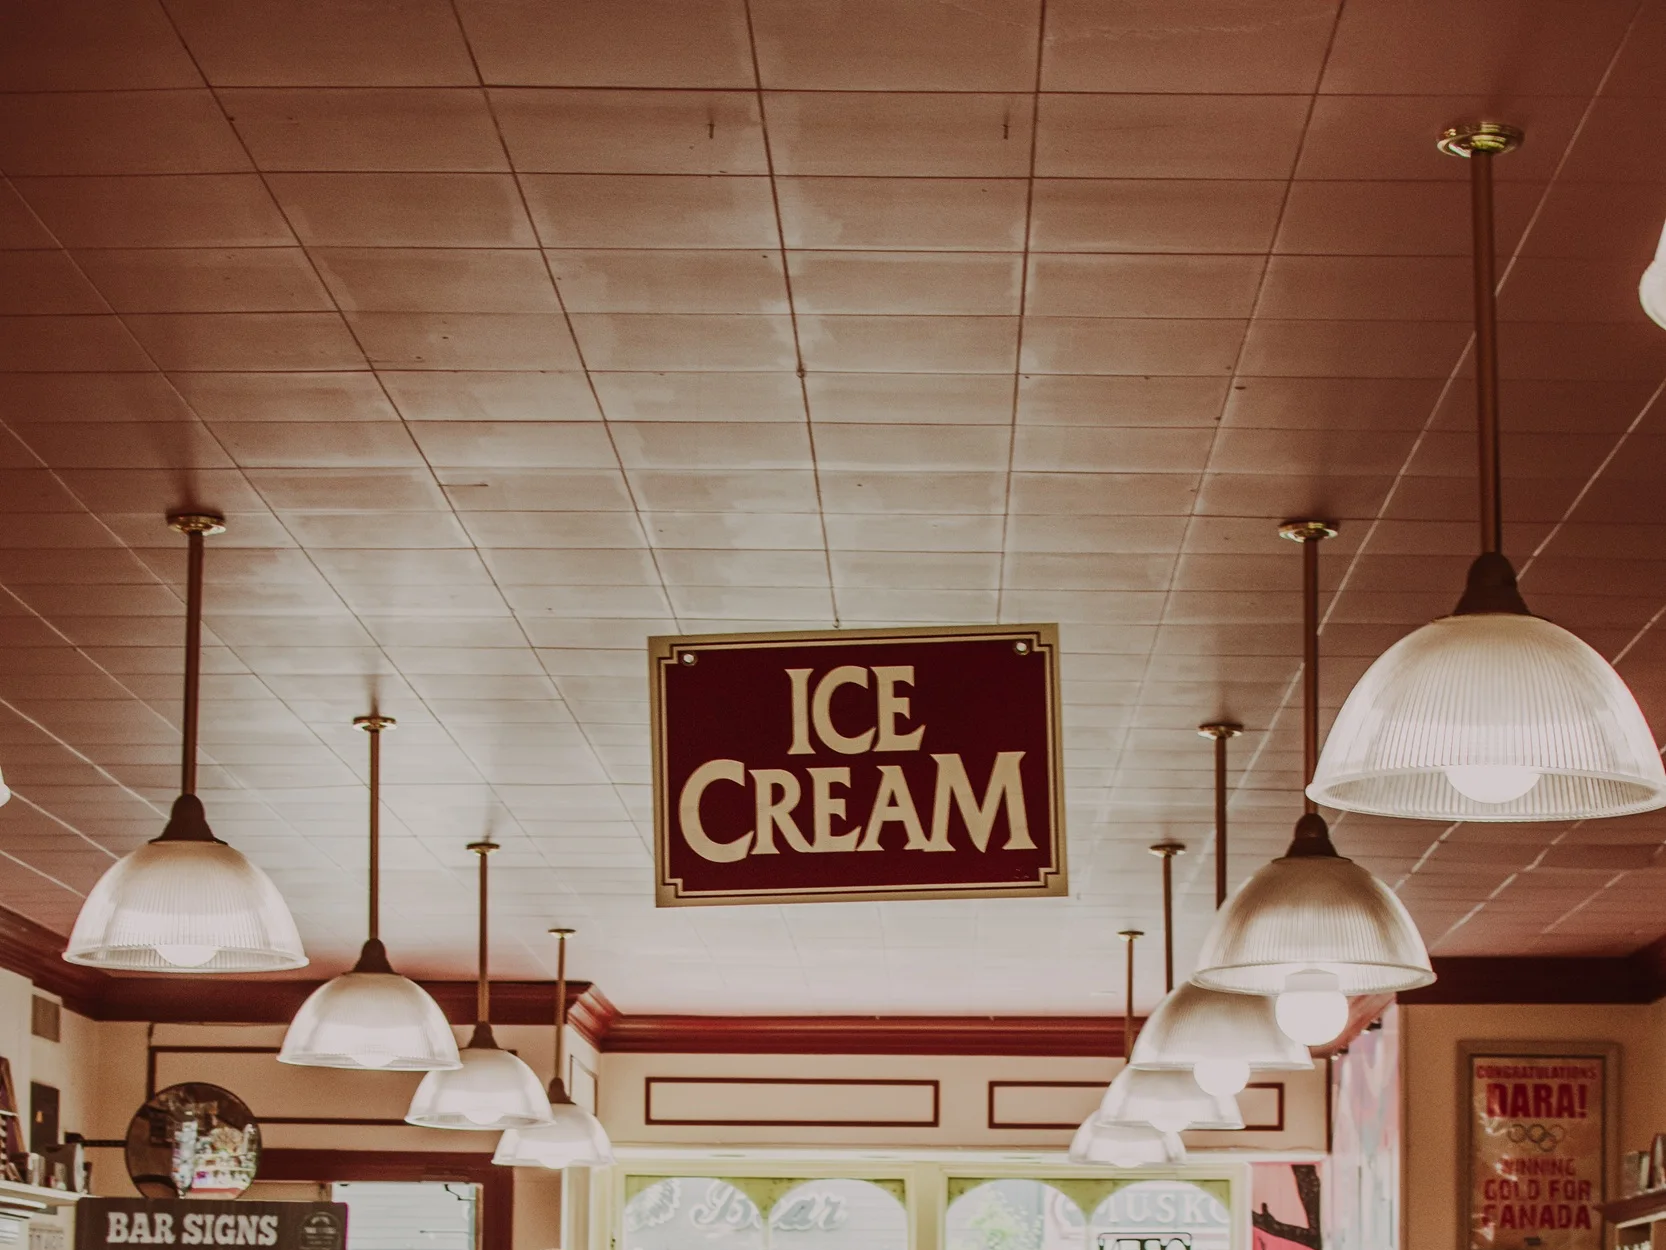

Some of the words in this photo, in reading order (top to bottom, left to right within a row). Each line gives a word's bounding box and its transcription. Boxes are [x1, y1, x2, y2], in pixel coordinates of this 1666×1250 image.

[784, 665, 926, 755] ICE
[679, 751, 1038, 863] CREAM
[1486, 1083, 1588, 1118] DARA!
[1483, 1179, 1542, 1200] GOLD
[1549, 1179, 1592, 1200] FOR
[107, 1211, 176, 1244] BAR
[181, 1213, 279, 1246] SIGNS
[1482, 1203, 1593, 1230] CANADA
